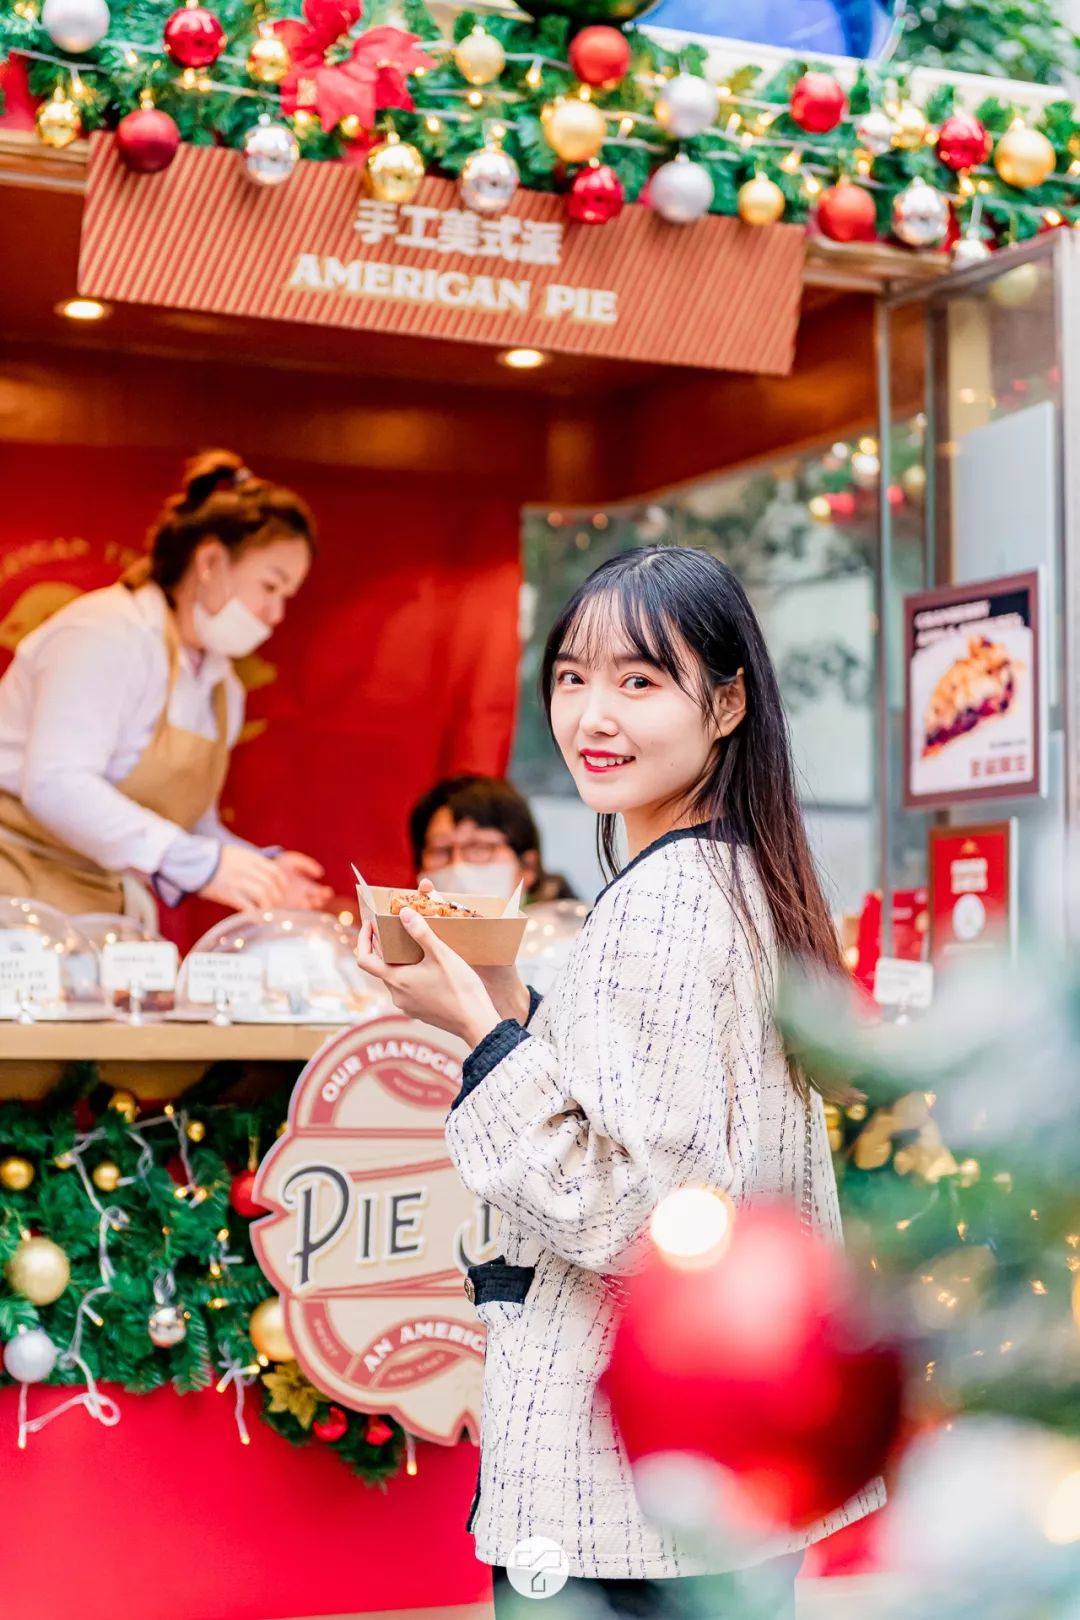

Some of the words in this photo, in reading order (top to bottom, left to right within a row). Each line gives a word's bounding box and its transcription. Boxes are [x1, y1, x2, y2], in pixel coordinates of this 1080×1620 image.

[353, 198, 564, 266] 手工美式派
[289, 252, 531, 311] AMERICAN
[545, 283, 617, 323] PIE
[321, 1055, 363, 1103] OUR
[366, 1040, 463, 1083] HANDCR
[282, 1164, 423, 1287] PIE
[363, 1337, 394, 1373] AN
[400, 1321, 487, 1354] AMERIC
